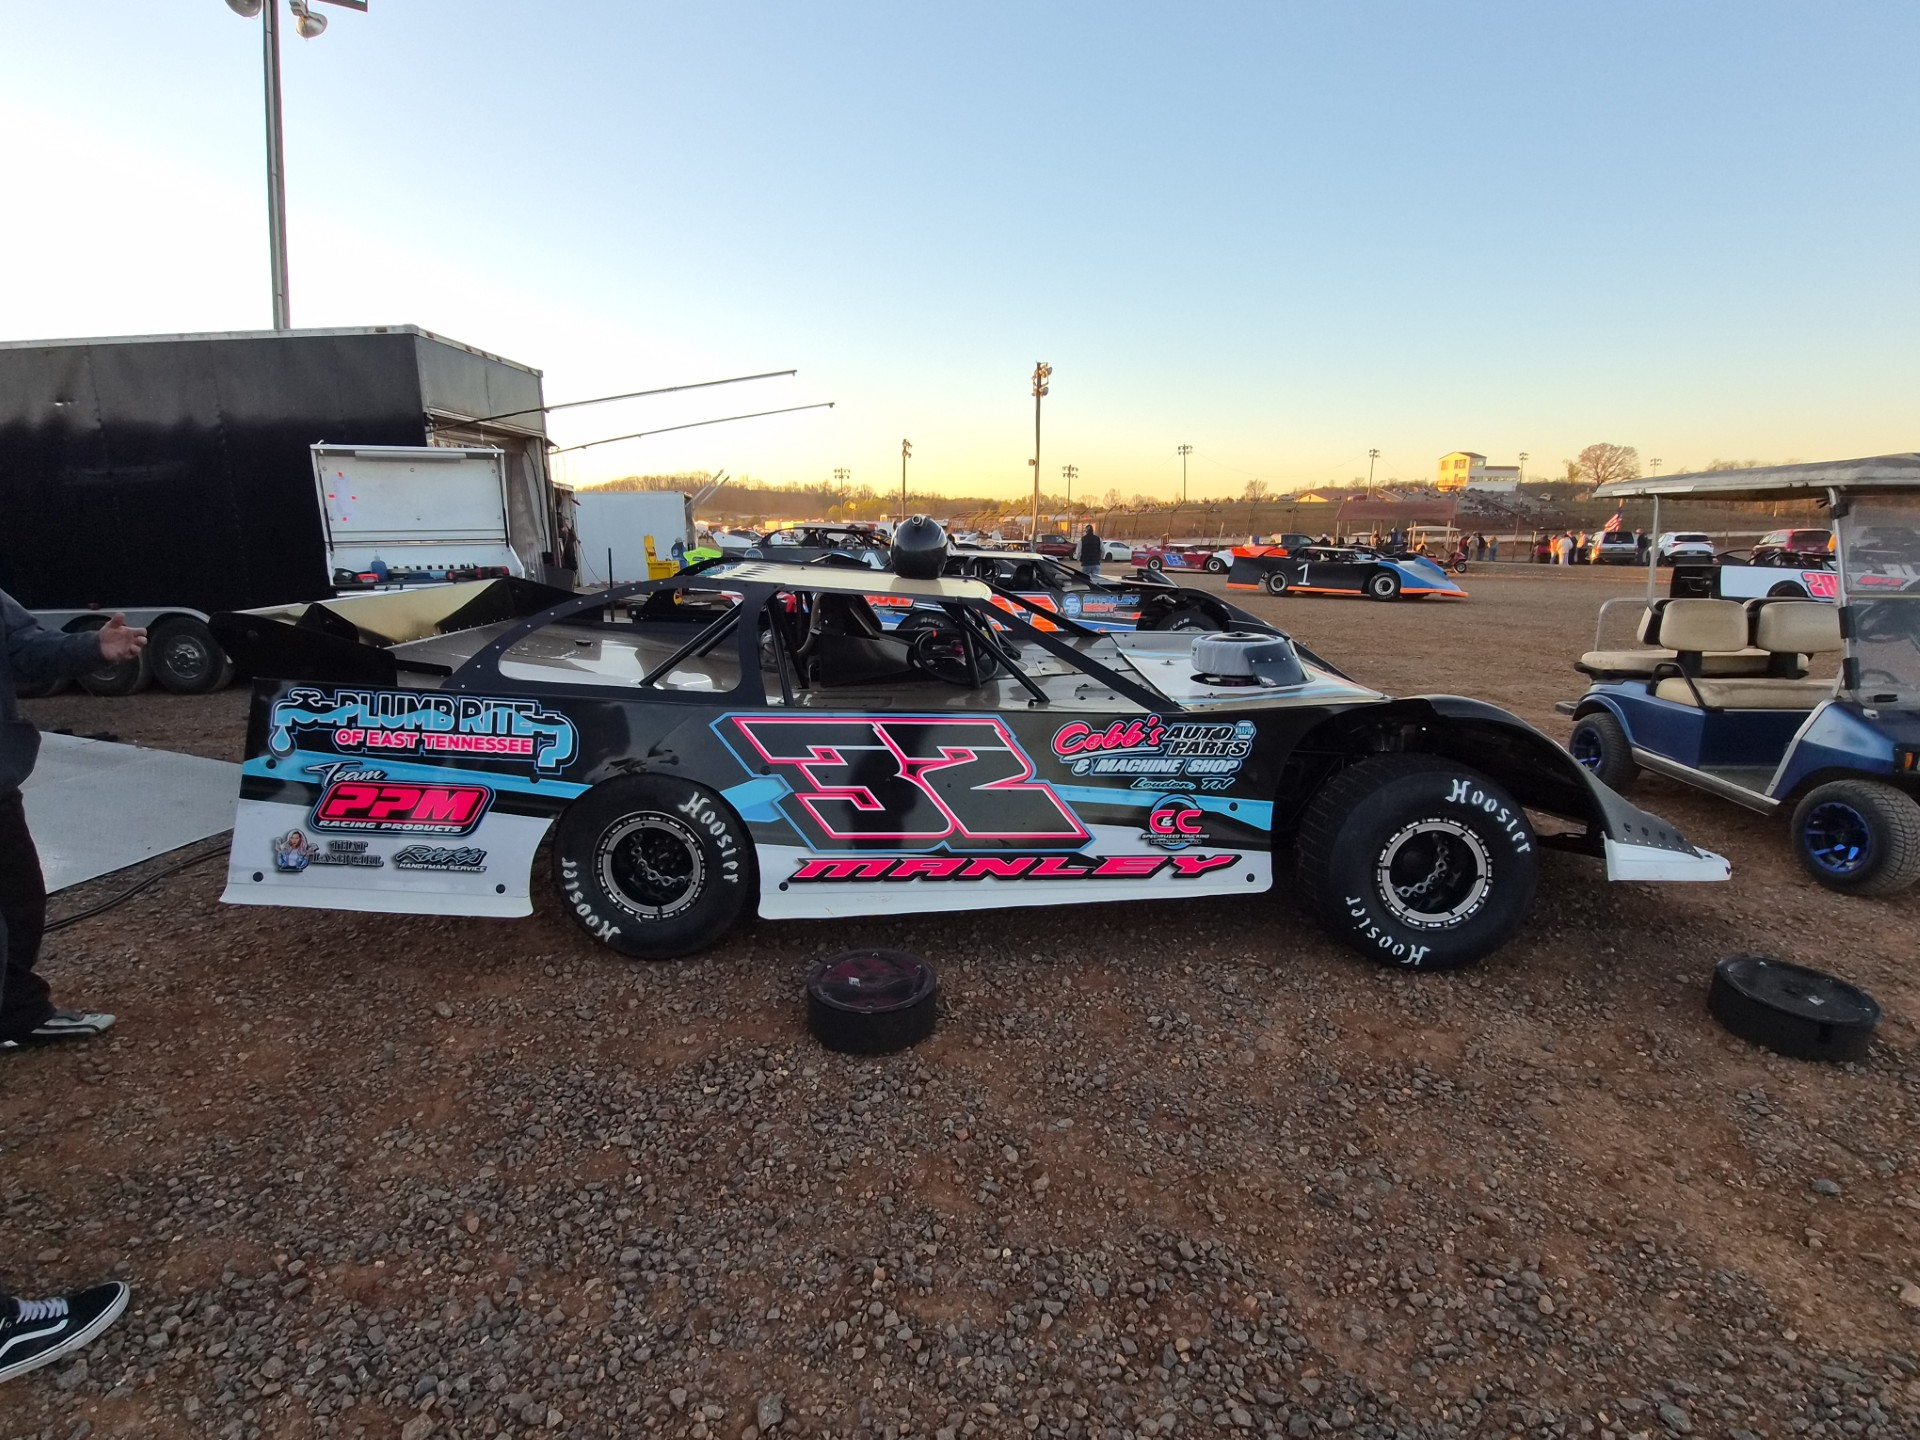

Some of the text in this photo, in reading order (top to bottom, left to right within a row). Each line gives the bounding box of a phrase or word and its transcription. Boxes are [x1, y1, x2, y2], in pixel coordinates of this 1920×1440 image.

[1297, 562, 1311, 585] 1
[337, 692, 535, 735] PLUMB RITE
[336, 728, 534, 754] OF EAST TENNESSEE
[1054, 716, 1166, 754] Cobb's
[1164, 725, 1233, 741] AUTO
[1169, 740, 1249, 756] PARTS
[306, 760, 384, 788] Team
[731, 715, 1091, 841] 32
[1074, 758, 1240, 774] & MACHINE SHOP
[1130, 777, 1236, 790] Loudon, TN
[325, 786, 480, 820] PPM
[1445, 778, 1531, 853] Hoosier
[319, 820, 462, 833] RACING PRODUCTS
[677, 791, 739, 883] Hoosier
[399, 862, 447, 870] HANDYMAN
[792, 855, 1238, 878] MANLEY
[561, 857, 621, 942] Hoosier
[1345, 896, 1431, 965] Hoosier
